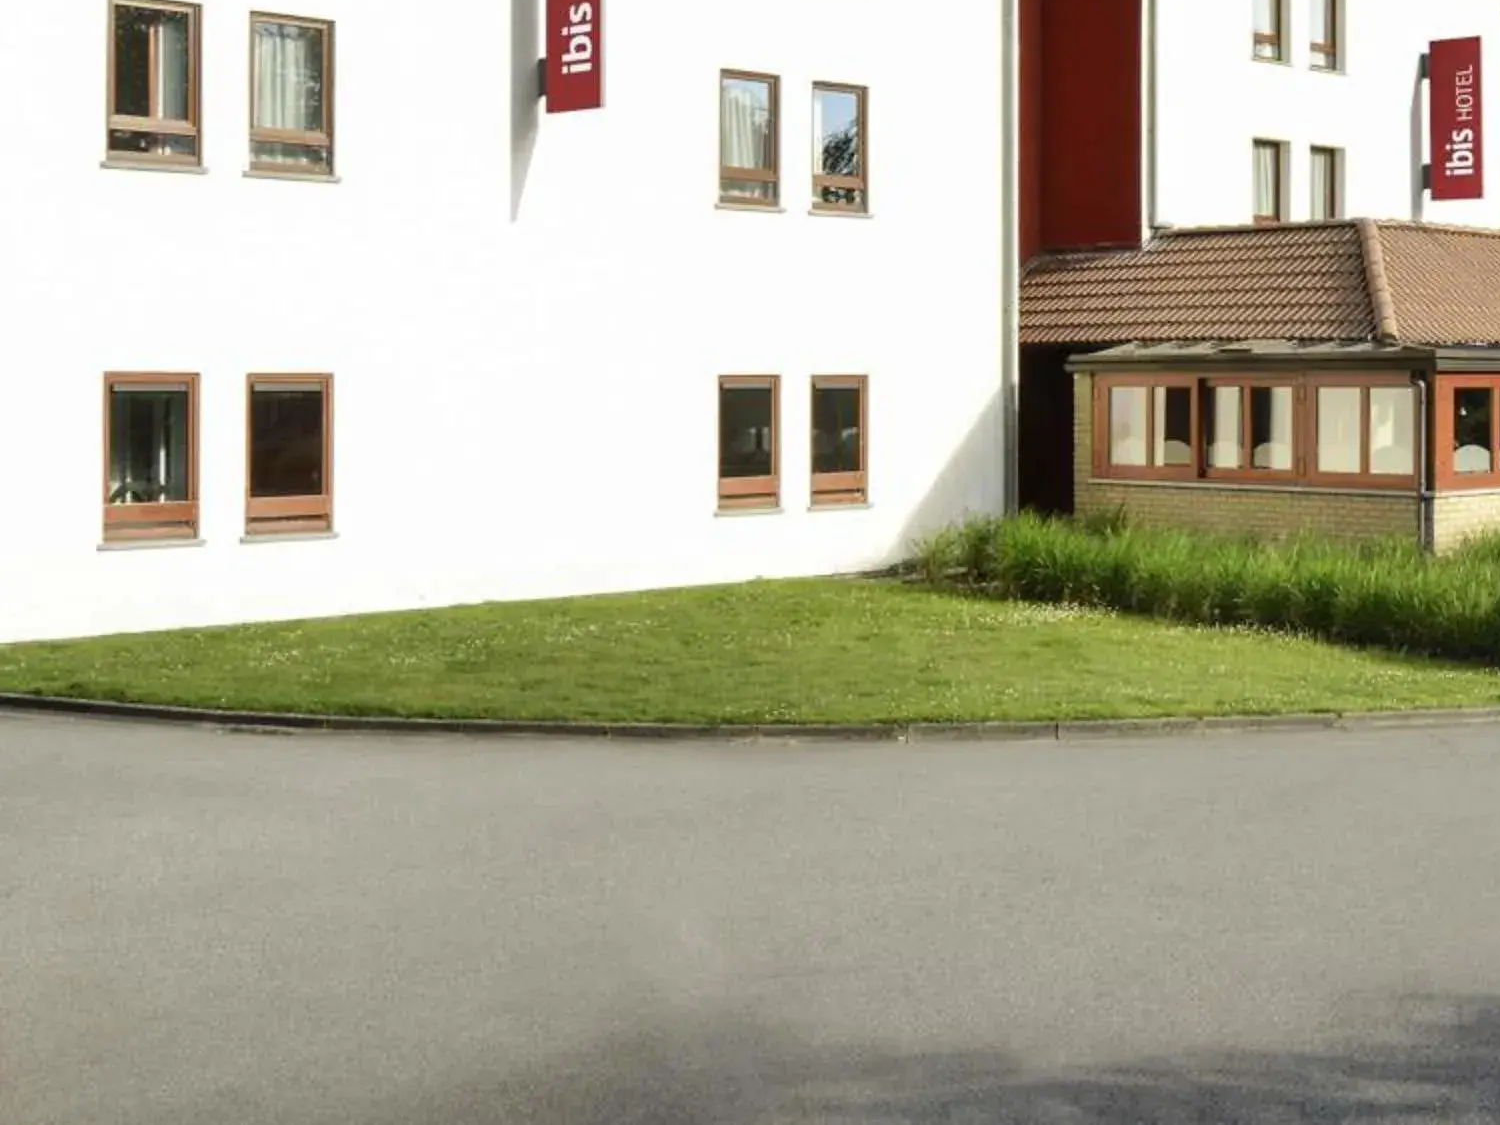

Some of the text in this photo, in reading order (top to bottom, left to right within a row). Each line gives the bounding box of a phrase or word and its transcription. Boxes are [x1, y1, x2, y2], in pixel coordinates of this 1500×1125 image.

[562, 2, 592, 75] ibis
[1445, 64, 1474, 177] ibis HOTEL
